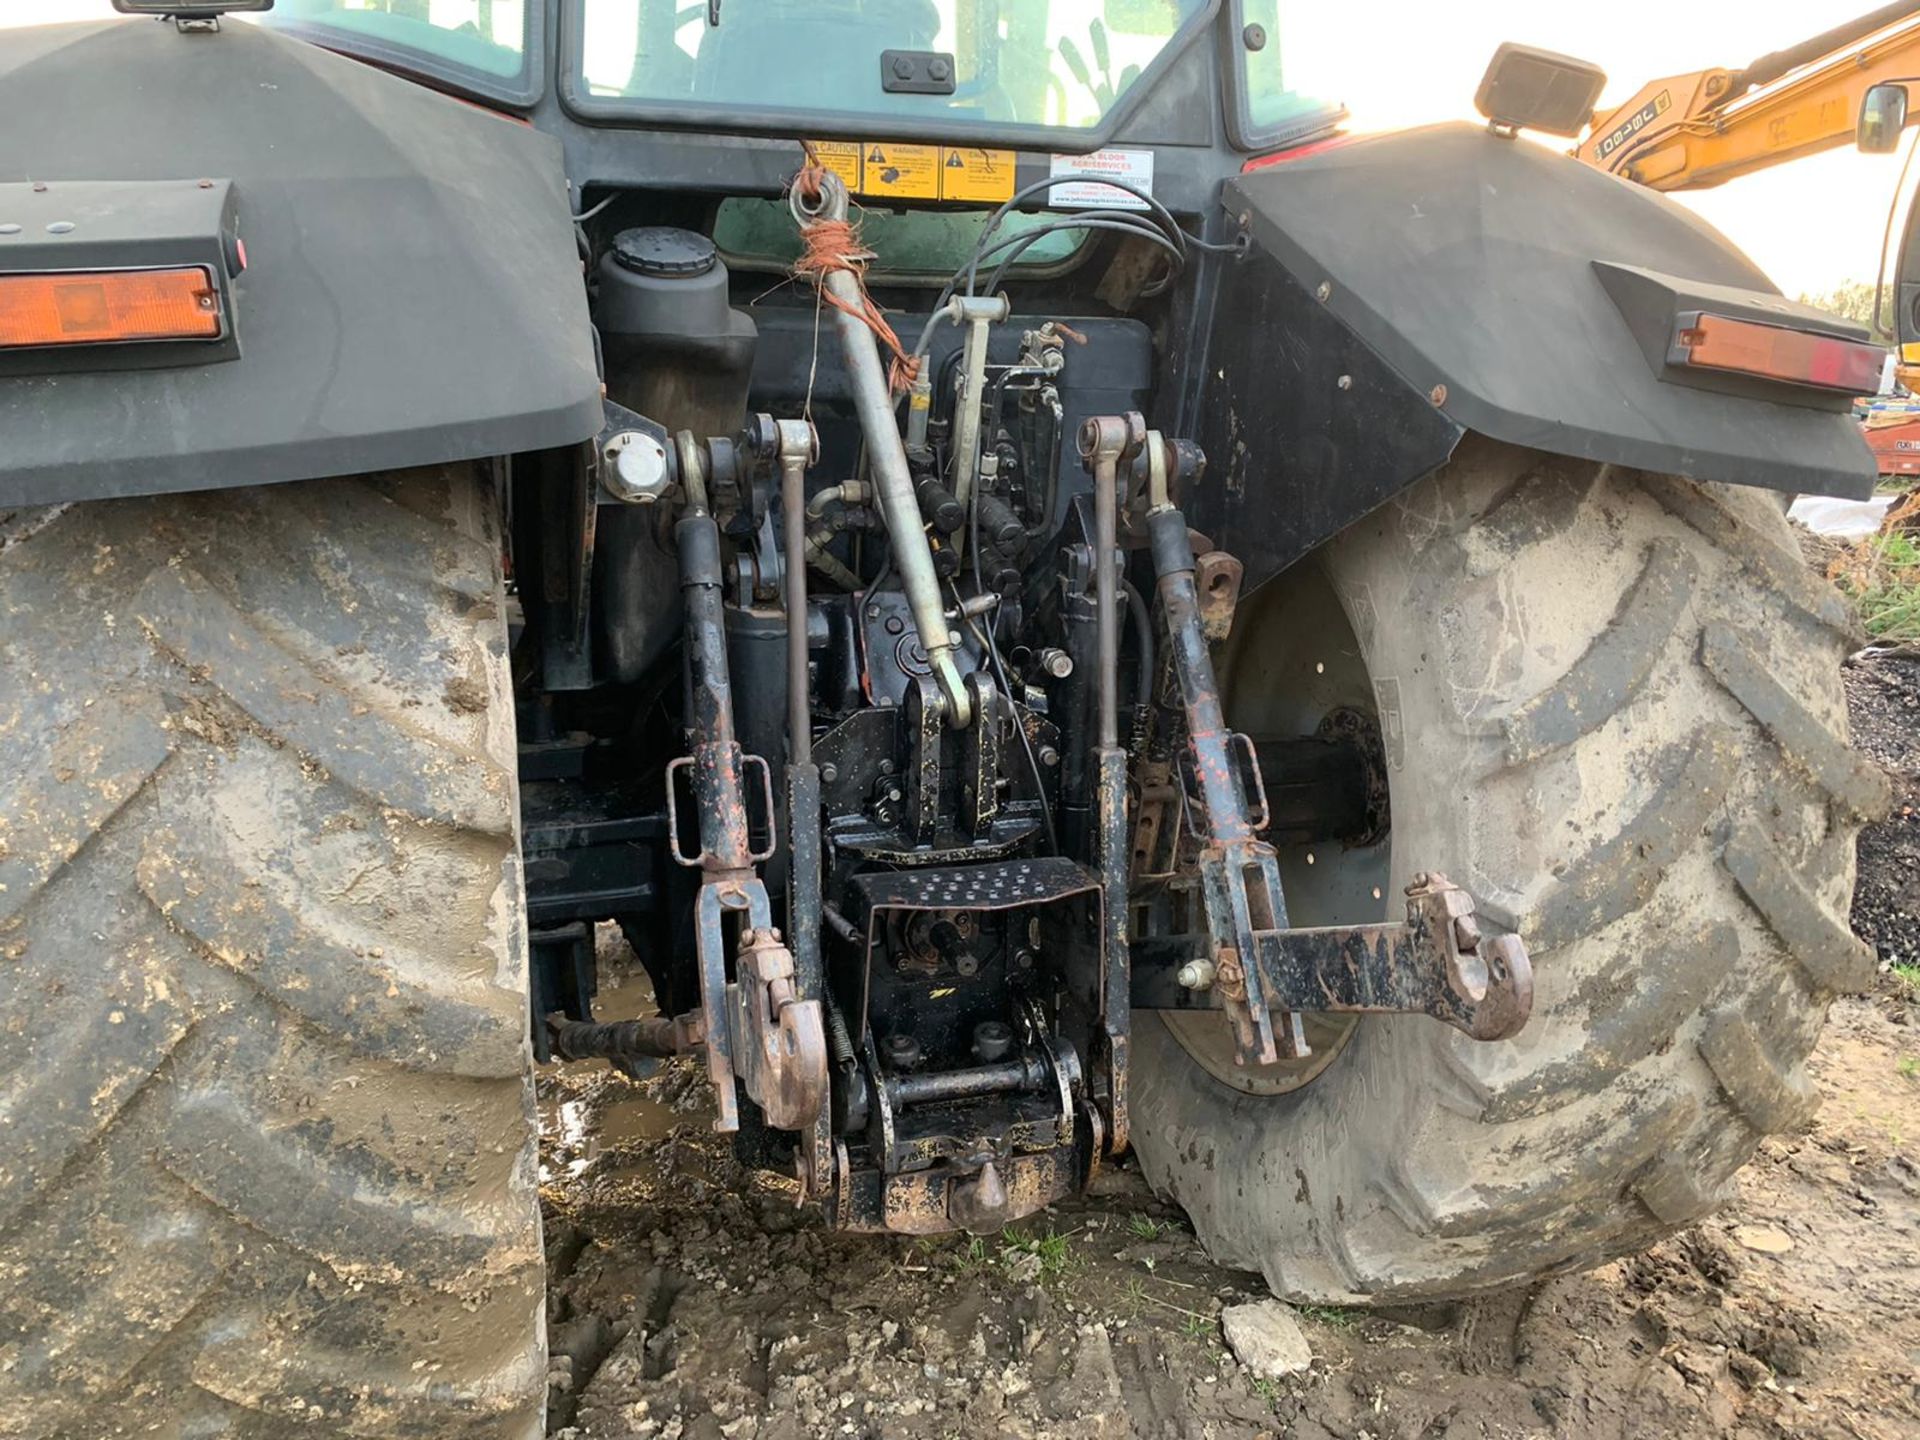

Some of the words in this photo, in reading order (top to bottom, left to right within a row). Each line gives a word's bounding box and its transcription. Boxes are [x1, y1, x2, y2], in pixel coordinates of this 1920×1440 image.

[1603, 110, 1654, 153] JS160
[820, 142, 858, 153] CAUTION
[969, 151, 998, 160] CAUTON
[1072, 160, 1132, 171] AGRISERVICES
